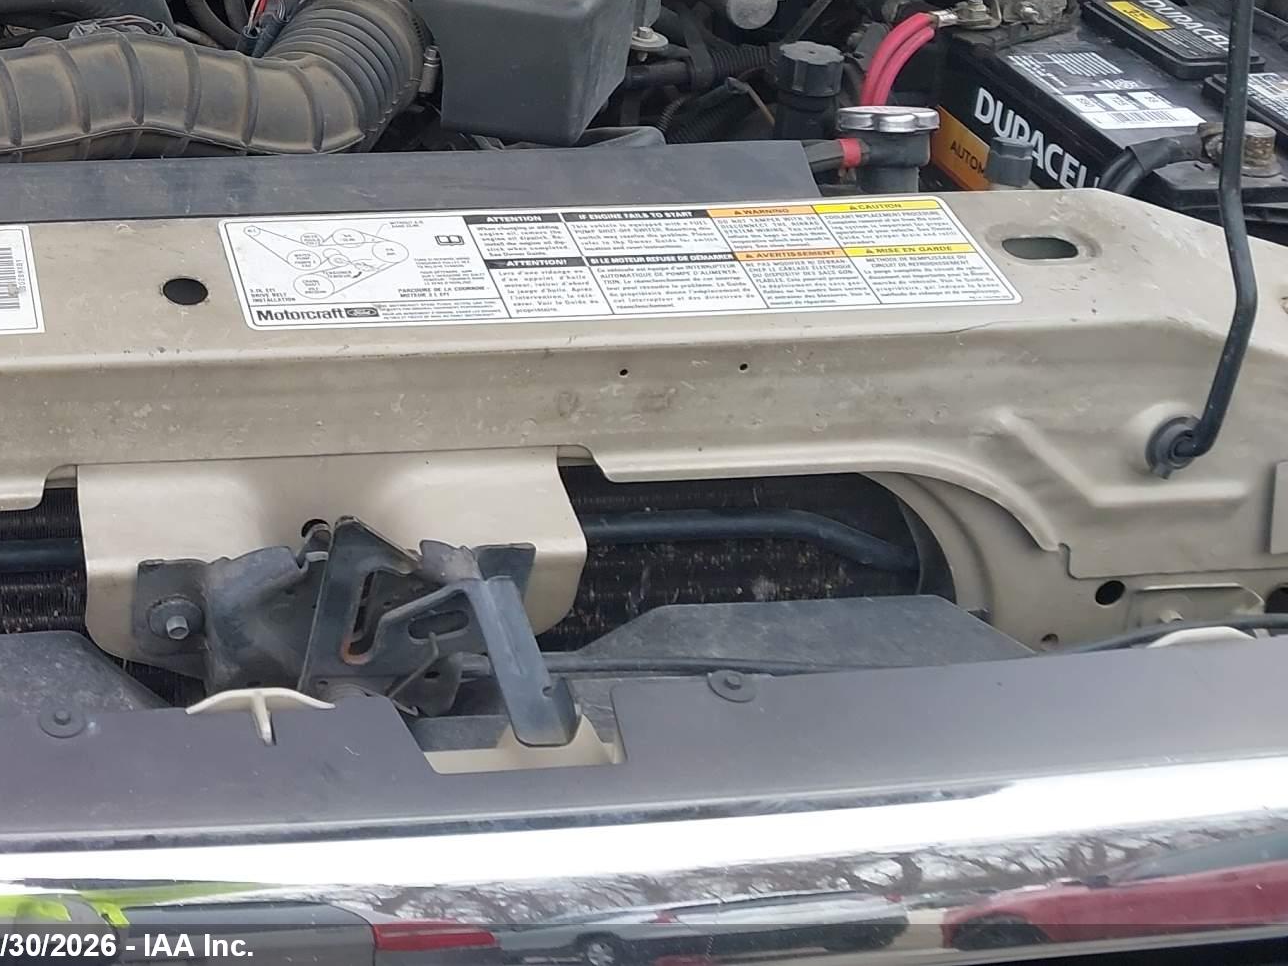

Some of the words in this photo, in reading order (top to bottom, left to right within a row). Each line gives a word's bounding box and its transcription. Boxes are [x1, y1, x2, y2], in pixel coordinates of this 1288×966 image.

[974, 87, 1101, 189] DURACEL
[757, 250, 836, 258] AVERTISSEMENT
[256, 308, 345, 322] Motorcraft
